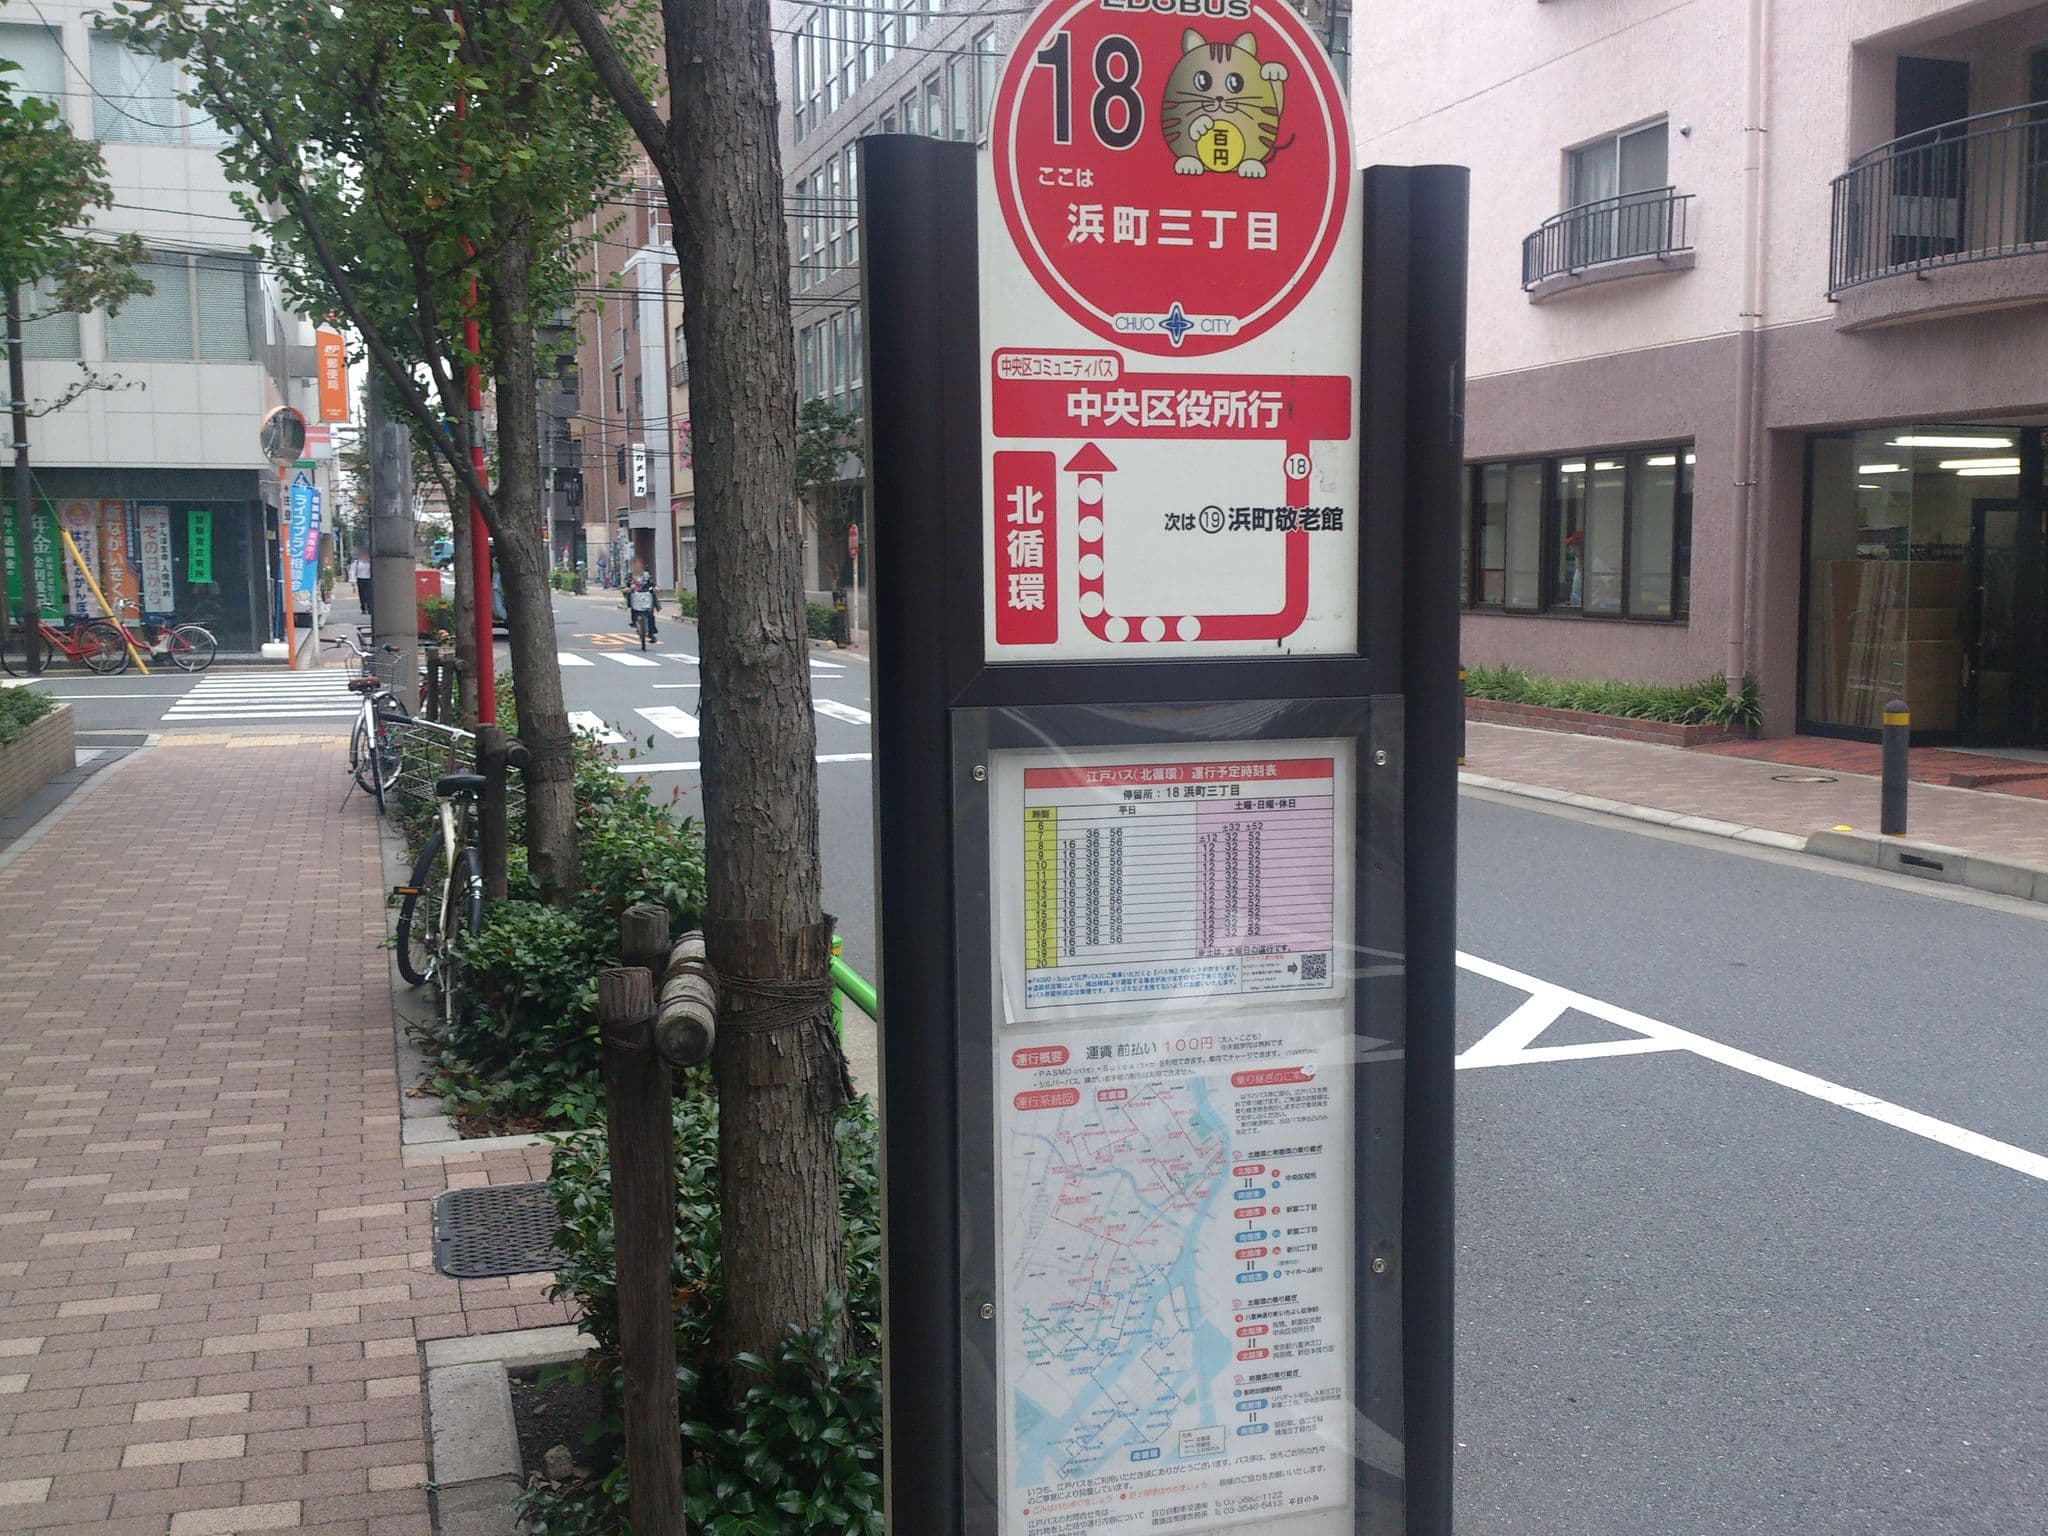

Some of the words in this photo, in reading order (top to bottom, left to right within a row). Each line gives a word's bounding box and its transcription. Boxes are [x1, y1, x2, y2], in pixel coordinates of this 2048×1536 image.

[1036, 31, 1144, 150] 18
[1212, 128, 1230, 167] 百円
[1038, 166, 1094, 188] ここは
[1066, 202, 1279, 251] 浜町三丁目
[1115, 316, 1156, 333] CHUO
[1200, 318, 1233, 333] CITY
[1000, 357, 1114, 378] 中央区コミュニティバス
[1066, 387, 1284, 429] 中央区役所行
[1288, 458, 1307, 475] 18
[1006, 485, 1046, 612] 北循環
[1165, 787, 1180, 799] 18
[1183, 784, 1240, 799] 浜町三丁目
[1118, 805, 1137, 816] 平日
[1086, 830, 1100, 838] 36
[1109, 829, 1123, 837] 56
[1063, 840, 1076, 848] 16
[1086, 840, 1100, 848] 36
[1109, 838, 1123, 847] 56
[1063, 850, 1076, 858] 16
[1086, 849, 1100, 858] 36
[1109, 848, 1123, 856] 56
[1202, 843, 1215, 852] 12
[1035, 862, 1048, 870] 10
[1063, 860, 1076, 868] 16
[1086, 859, 1100, 867] 36
[1109, 858, 1123, 866] 56
[1202, 853, 1215, 861] 12
[1035, 872, 1048, 880] 11
[1063, 869, 1076, 878] 16
[1086, 869, 1100, 877] 36
[1109, 868, 1123, 876] 56
[1202, 862, 1215, 871] 12
[1035, 881, 1048, 890] 12
[1063, 879, 1076, 888] 16
[1086, 878, 1100, 887] 36
[1109, 877, 1123, 886] 56
[1202, 872, 1215, 881] 12
[1063, 889, 1076, 898] 16
[1086, 888, 1100, 896] 36
[1109, 887, 1123, 895] 56
[1202, 882, 1215, 890] 12
[1035, 901, 1048, 909] 14
[1063, 899, 1076, 907] 16
[1086, 898, 1100, 906] 36
[1109, 897, 1123, 905] 56
[1202, 891, 1215, 900] 12
[1035, 911, 1048, 919] 15
[1063, 909, 1076, 917] 16
[1086, 908, 1100, 916] 36
[1109, 906, 1123, 915] 56
[1202, 901, 1215, 909] 12
[1035, 920, 1048, 929] 16
[1063, 918, 1076, 927] 16
[1086, 917, 1100, 926] 36
[1109, 916, 1123, 924] 56
[1202, 910, 1215, 919] 12
[1035, 930, 1048, 938] 17
[1063, 928, 1076, 937] 16
[1086, 927, 1100, 935] 36
[1109, 926, 1123, 934] 56
[1202, 920, 1215, 929] 12
[1063, 938, 1076, 946] 16
[1086, 937, 1100, 945] 36
[1109, 936, 1123, 944] 56
[1202, 930, 1215, 938] 12
[1063, 948, 1076, 956] 16
[1202, 939, 1215, 948] 12
[1035, 959, 1048, 968] 20
[1085, 1045, 1112, 1060] 運賃
[1117, 1043, 1156, 1056] 前払い
